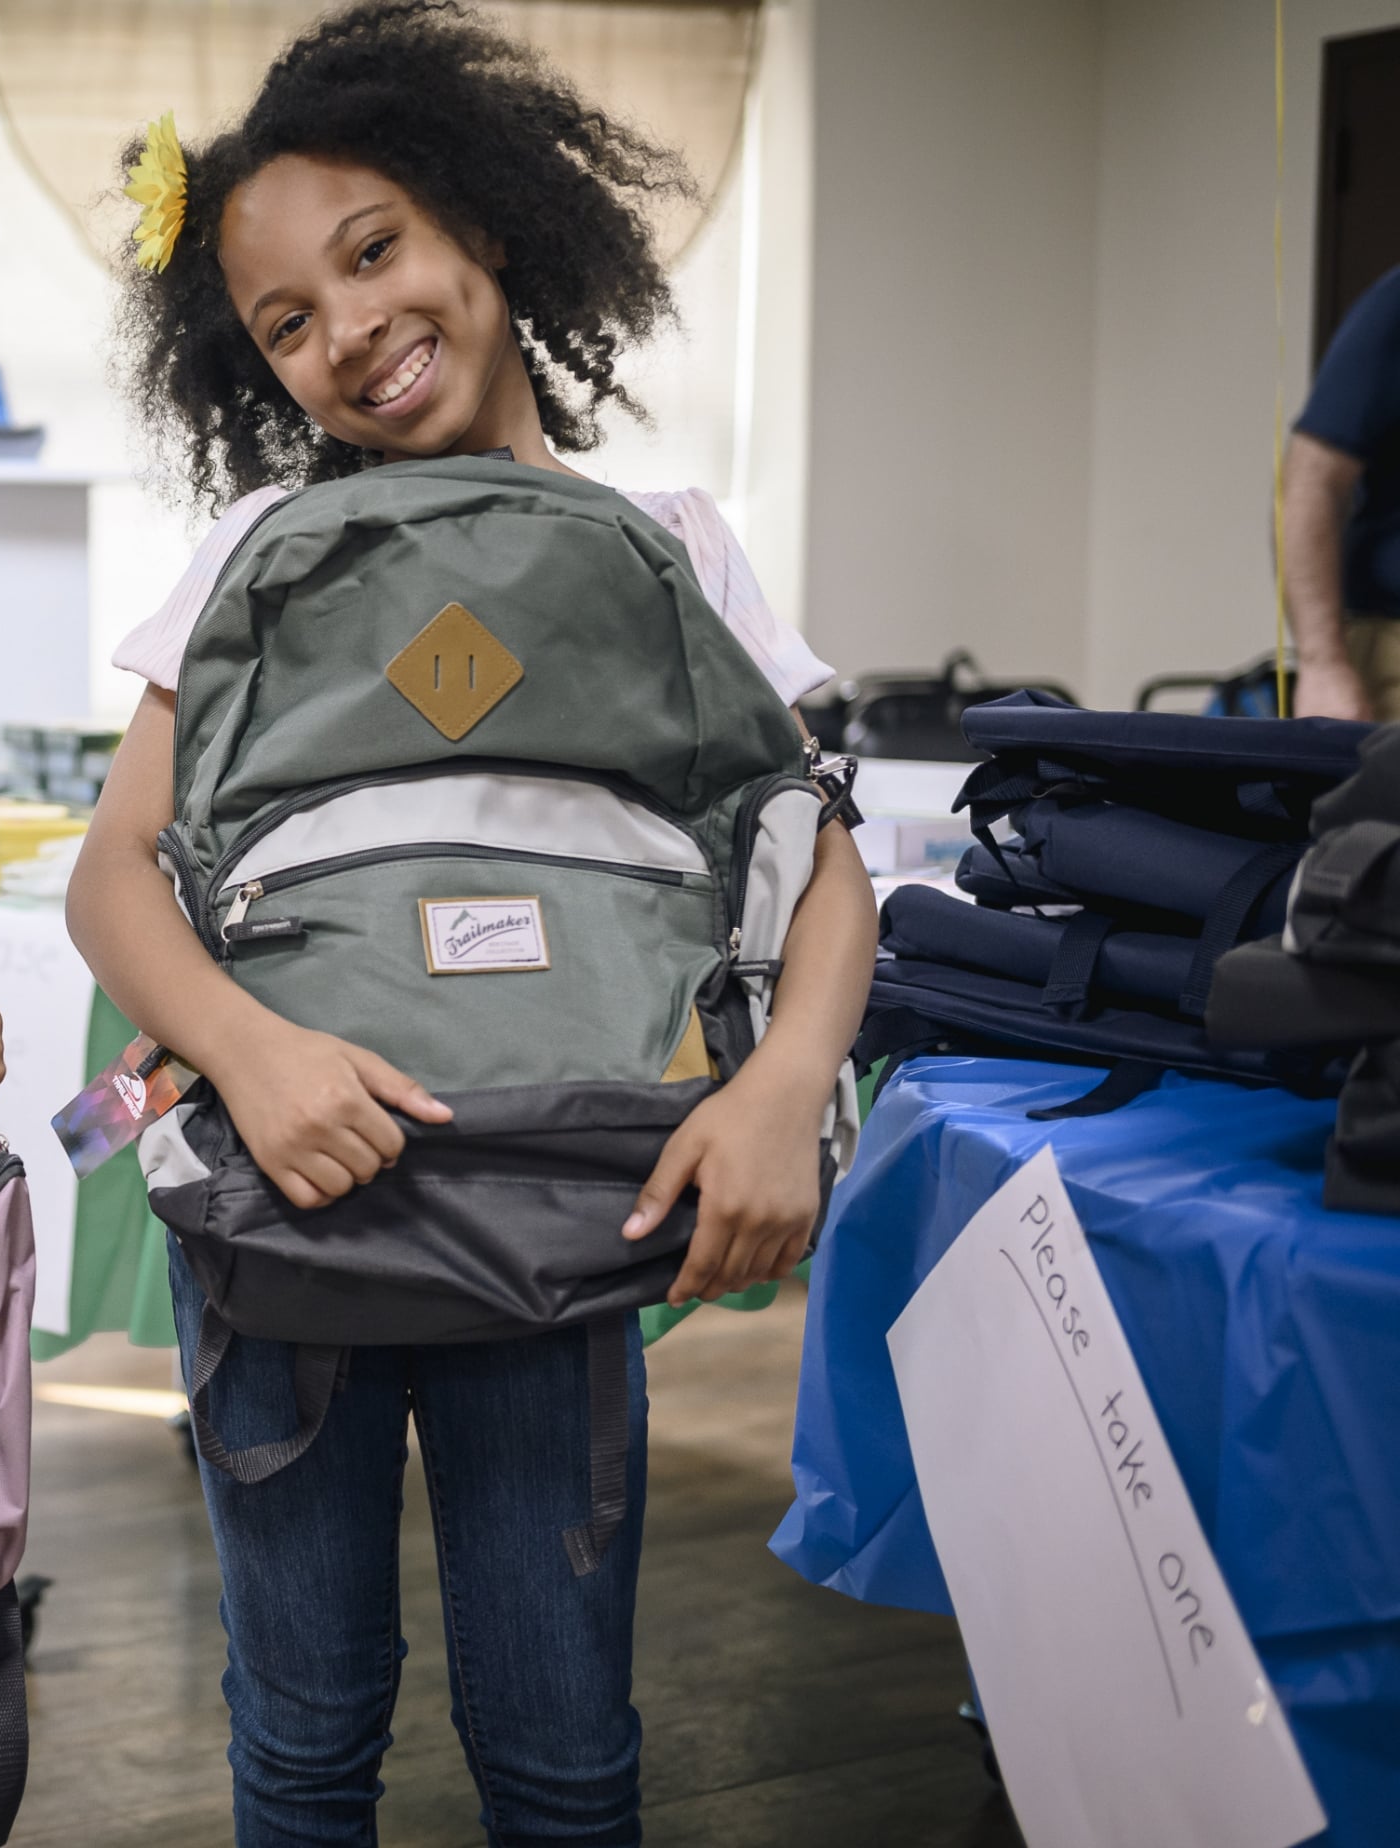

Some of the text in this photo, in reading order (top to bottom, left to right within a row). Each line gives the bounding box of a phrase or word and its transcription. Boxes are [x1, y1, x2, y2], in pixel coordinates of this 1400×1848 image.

[445, 914, 530, 957] Trailmaker
[1020, 1195, 1090, 1356] Please
[1101, 1391, 1152, 1509] take
